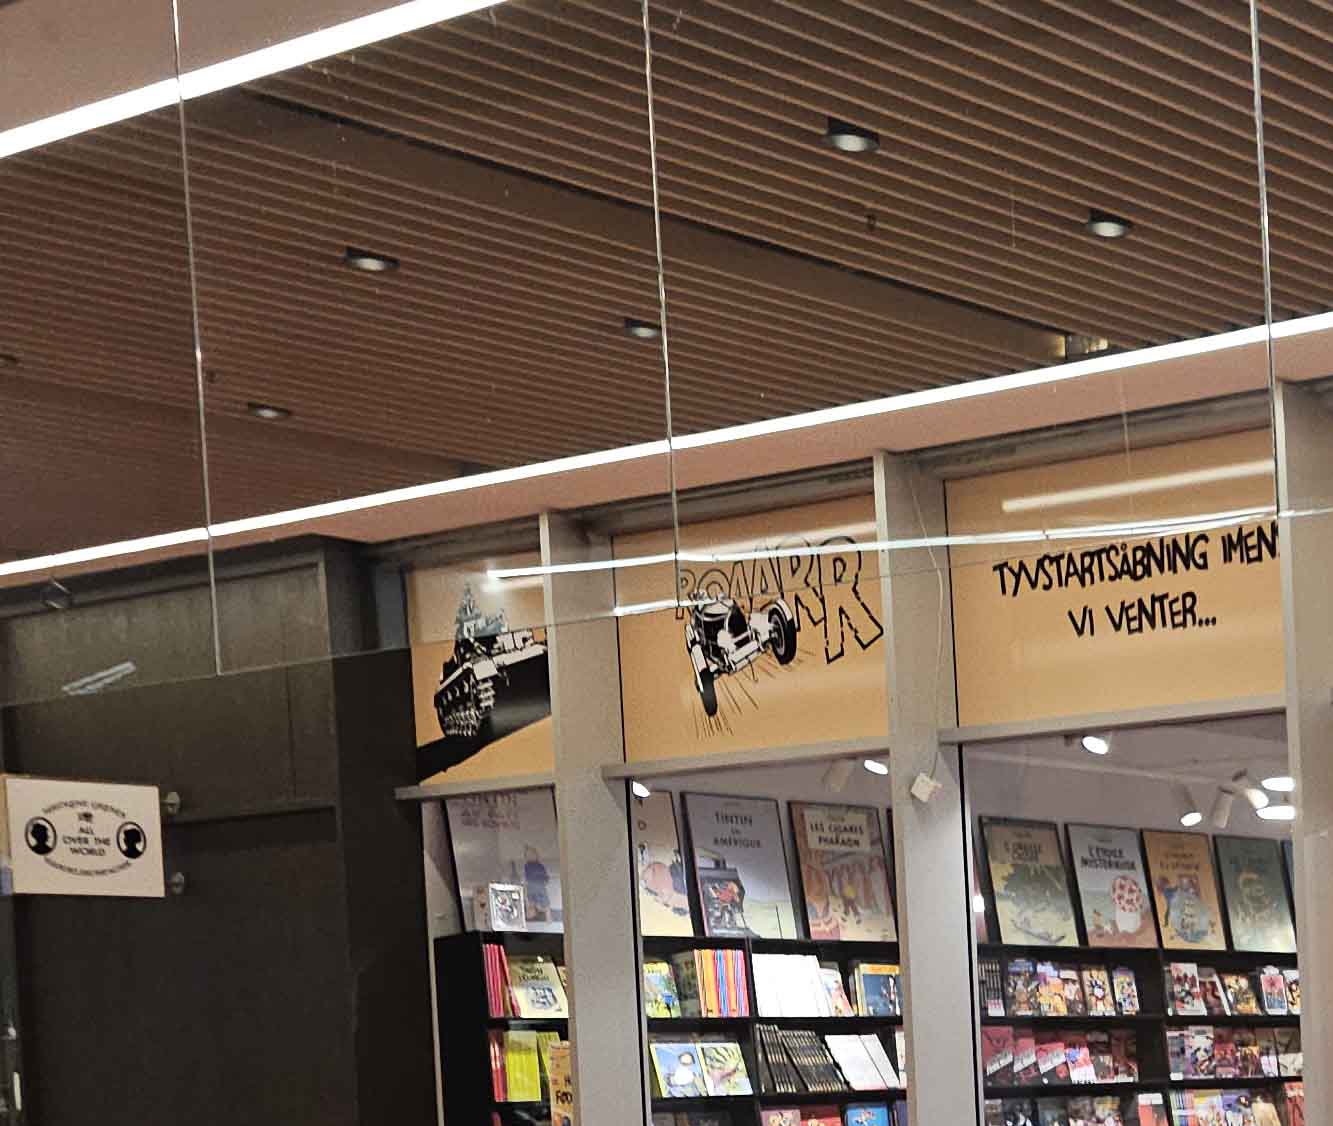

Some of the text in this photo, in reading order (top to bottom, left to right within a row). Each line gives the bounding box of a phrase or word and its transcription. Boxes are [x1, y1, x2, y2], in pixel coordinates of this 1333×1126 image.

[993, 533, 1210, 597] TYVSTARTSÅBNING
[1068, 591, 1217, 637] VI VENTER...
[62, 835, 111, 846] OVER THE
[69, 847, 106, 857] WORLD
